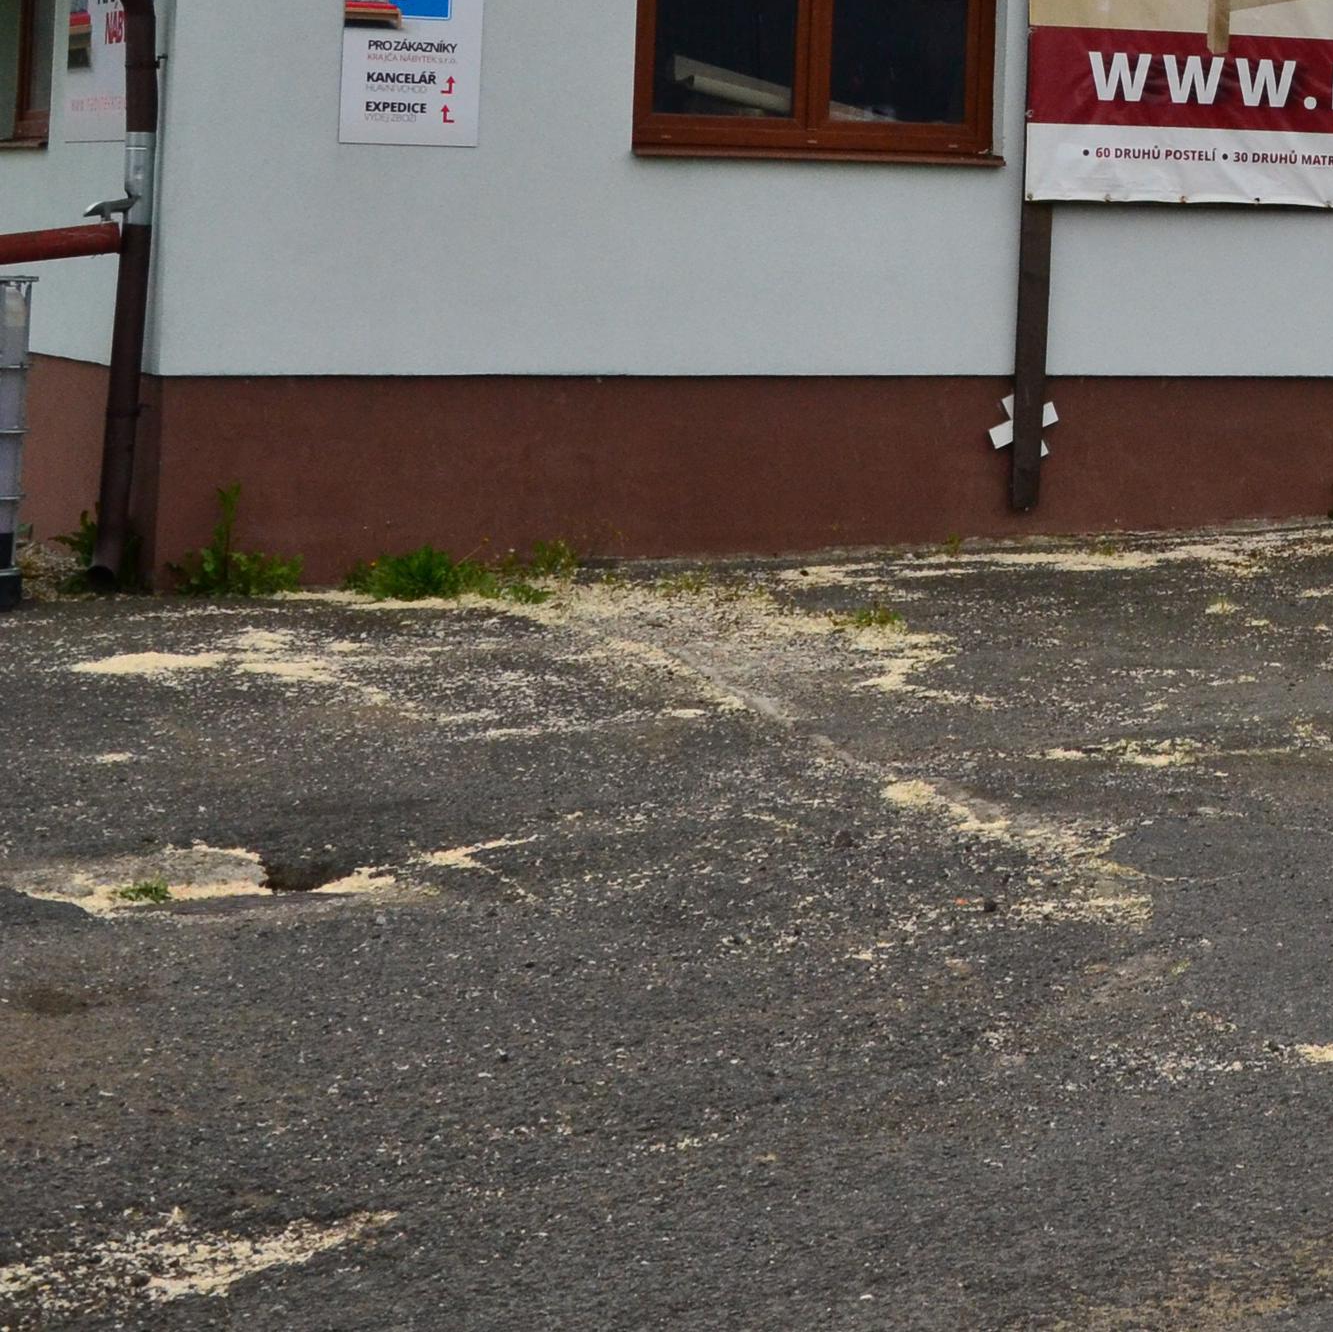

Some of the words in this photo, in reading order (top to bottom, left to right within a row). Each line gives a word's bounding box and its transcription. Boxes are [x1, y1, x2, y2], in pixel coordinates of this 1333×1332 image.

[368, 39, 393, 51] PRO
[393, 38, 458, 53] ZÁKAZNÍKY
[367, 52, 398, 62] KRAJČA
[366, 71, 437, 85] KANCELÁŘ
[365, 101, 427, 114] EXPEDICE
[1095, 147, 1111, 159] 60
[1114, 145, 1161, 160] DRUHŮ
[1164, 147, 1216, 162] POSTELÍ
[1233, 152, 1248, 163] 30
[1251, 150, 1298, 165] DRUHŮ
